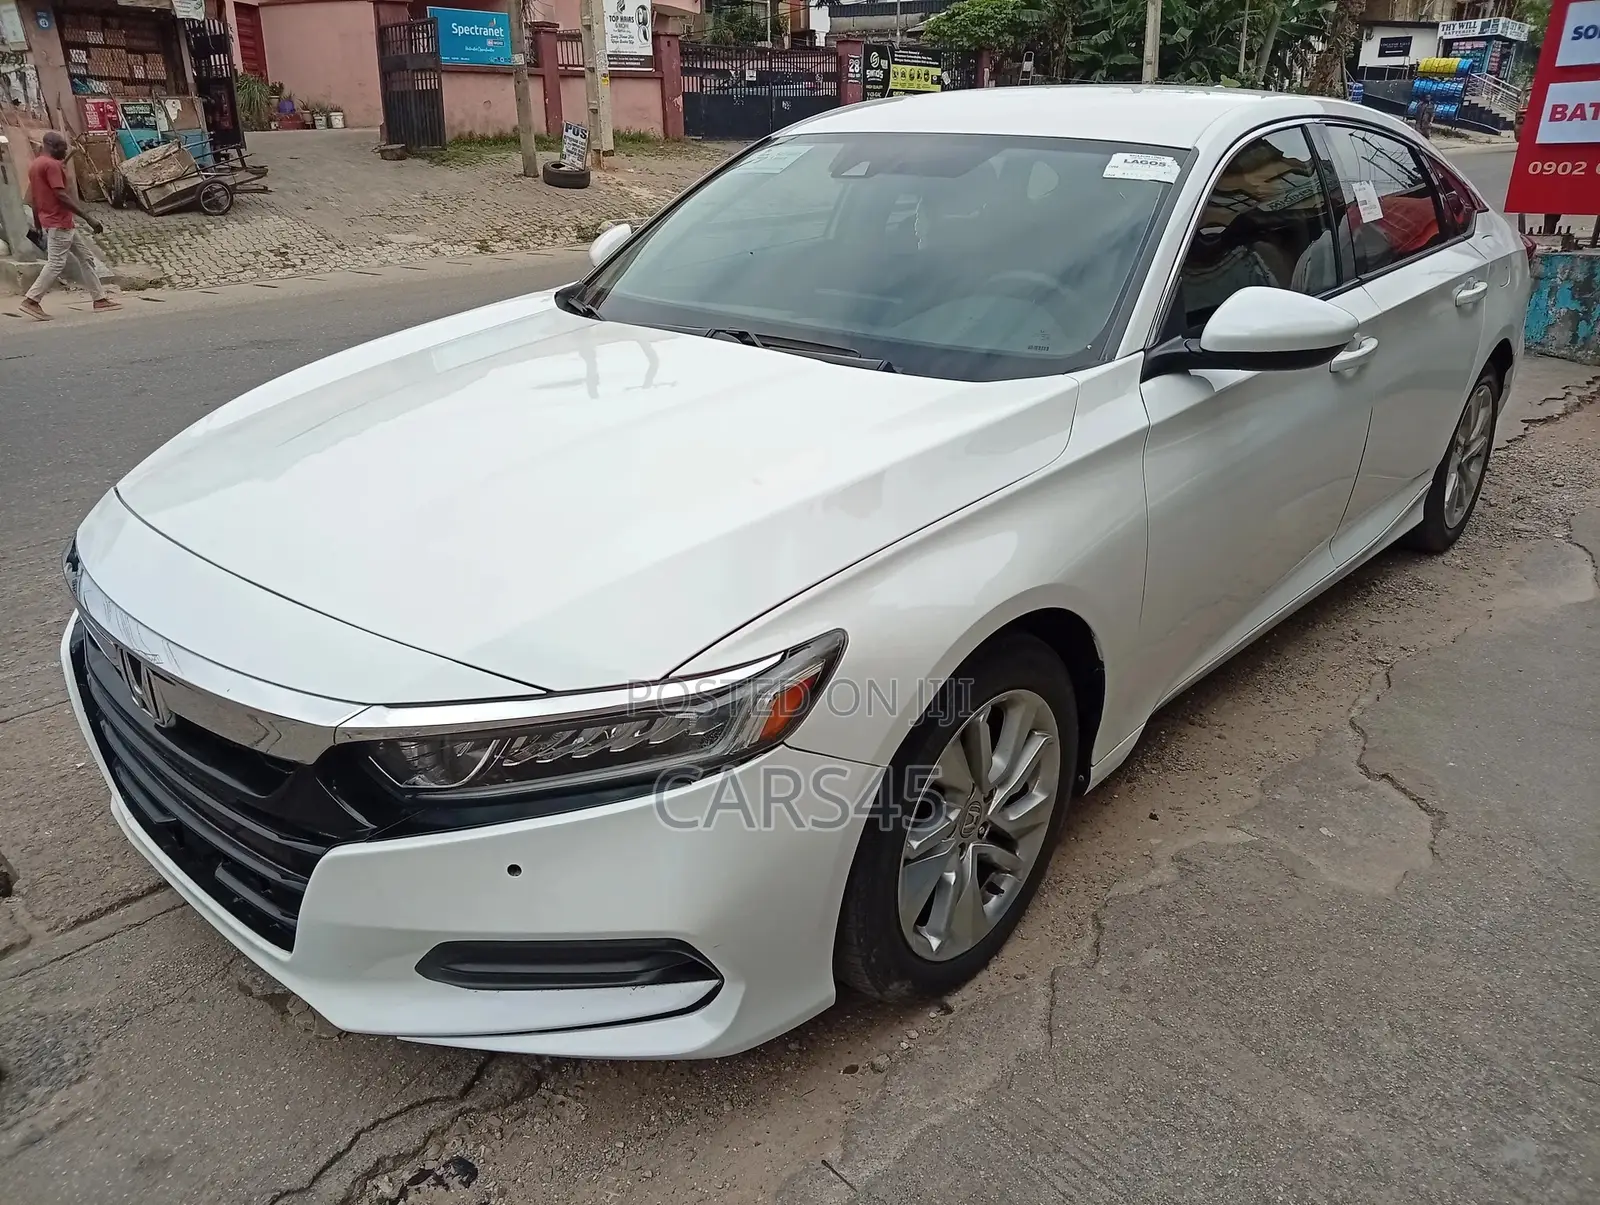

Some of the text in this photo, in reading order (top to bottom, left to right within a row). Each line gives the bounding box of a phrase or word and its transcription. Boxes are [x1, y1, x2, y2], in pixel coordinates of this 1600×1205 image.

[451, 22, 504, 37] Spectranet
[1441, 21, 1477, 32] THY WILL
[1570, 24, 1600, 41] SO
[848, 58, 860, 73] 28
[1123, 159, 1167, 167] LAGOS
[1527, 161, 1588, 176] 0902
